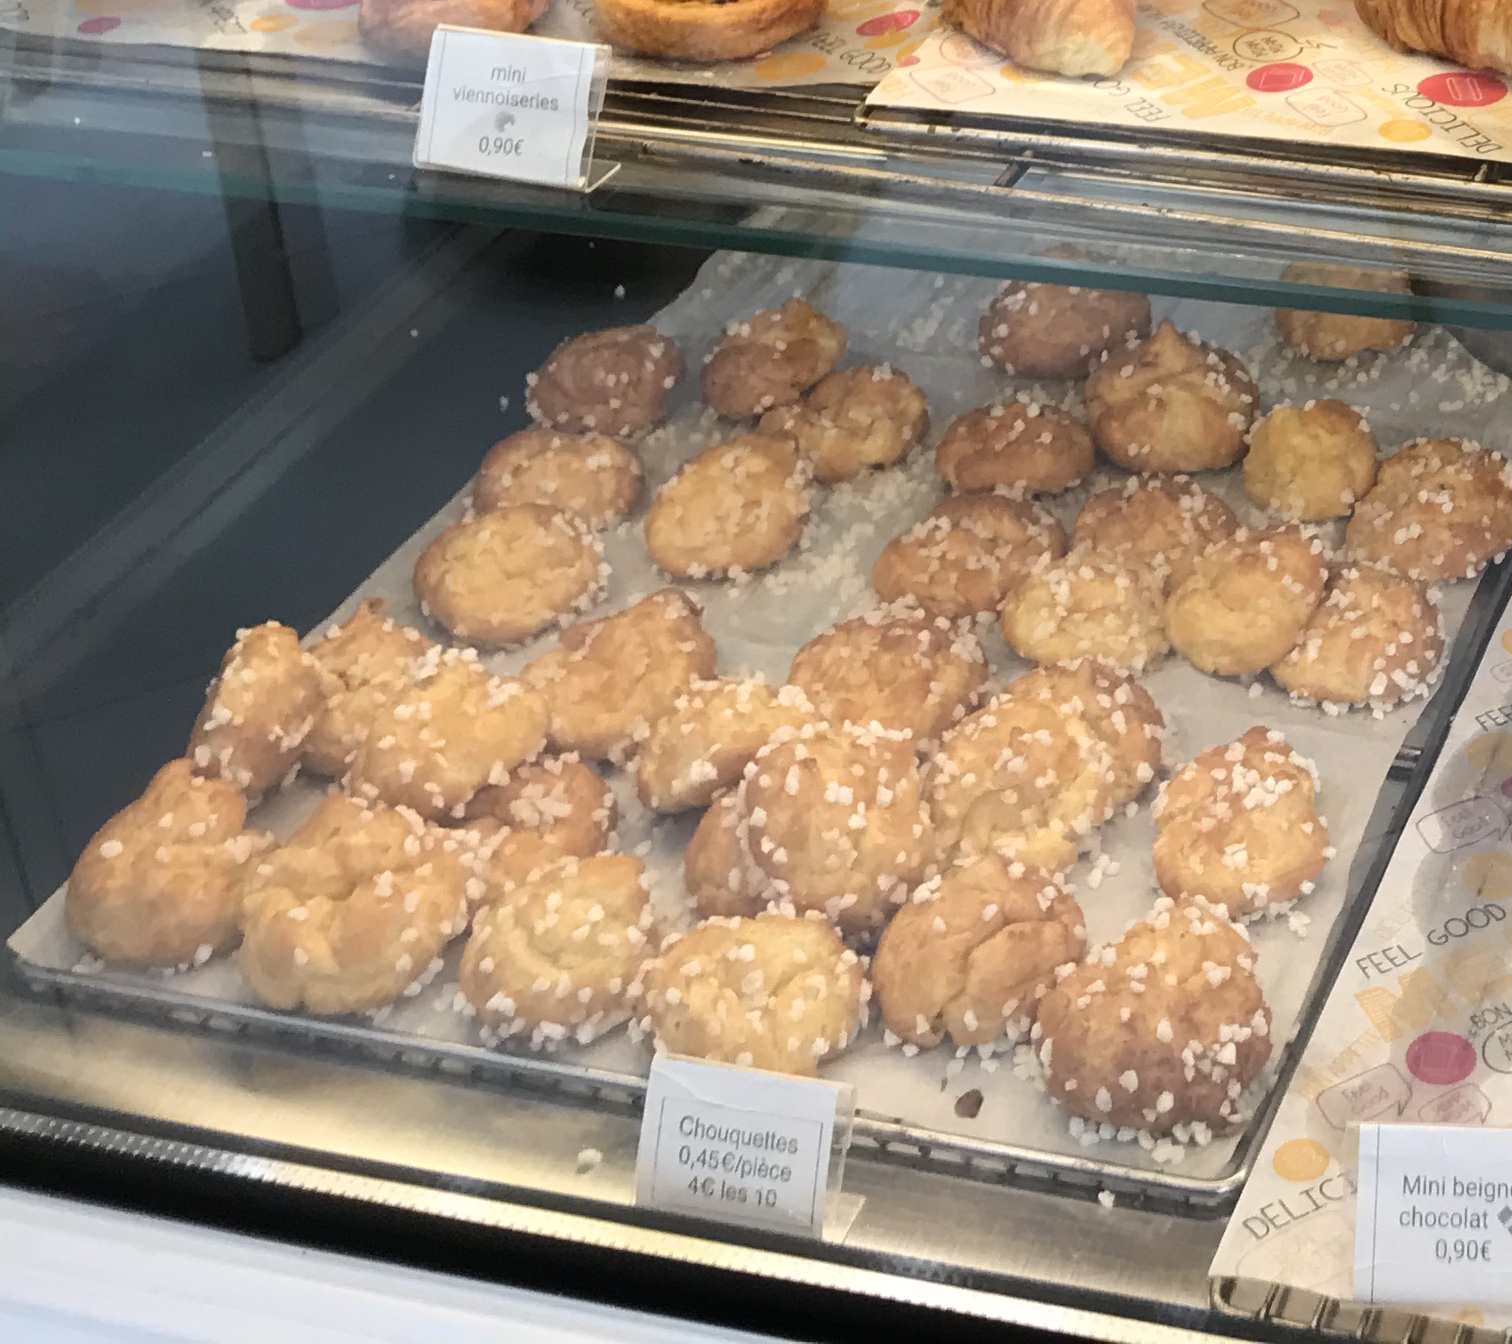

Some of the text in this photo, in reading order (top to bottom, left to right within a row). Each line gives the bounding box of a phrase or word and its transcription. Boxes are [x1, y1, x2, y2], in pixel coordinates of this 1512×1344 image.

[490, 66, 528, 83] mini
[453, 85, 559, 111] viennoiseries
[1381, 82, 1503, 155] DELICIOUS
[479, 136, 525, 156] 0,90€
[1356, 903, 1507, 980] FEEL GOOD
[1469, 1002, 1512, 1030] BON
[679, 1115, 799, 1154] Chouquettes
[720, 1180, 747, 1203] les
[755, 1188, 777, 1208] 10
[1402, 1175, 1446, 1196] Mini
[1399, 1206, 1488, 1229] chocolat
[1435, 1239, 1492, 1264] 0,90€
